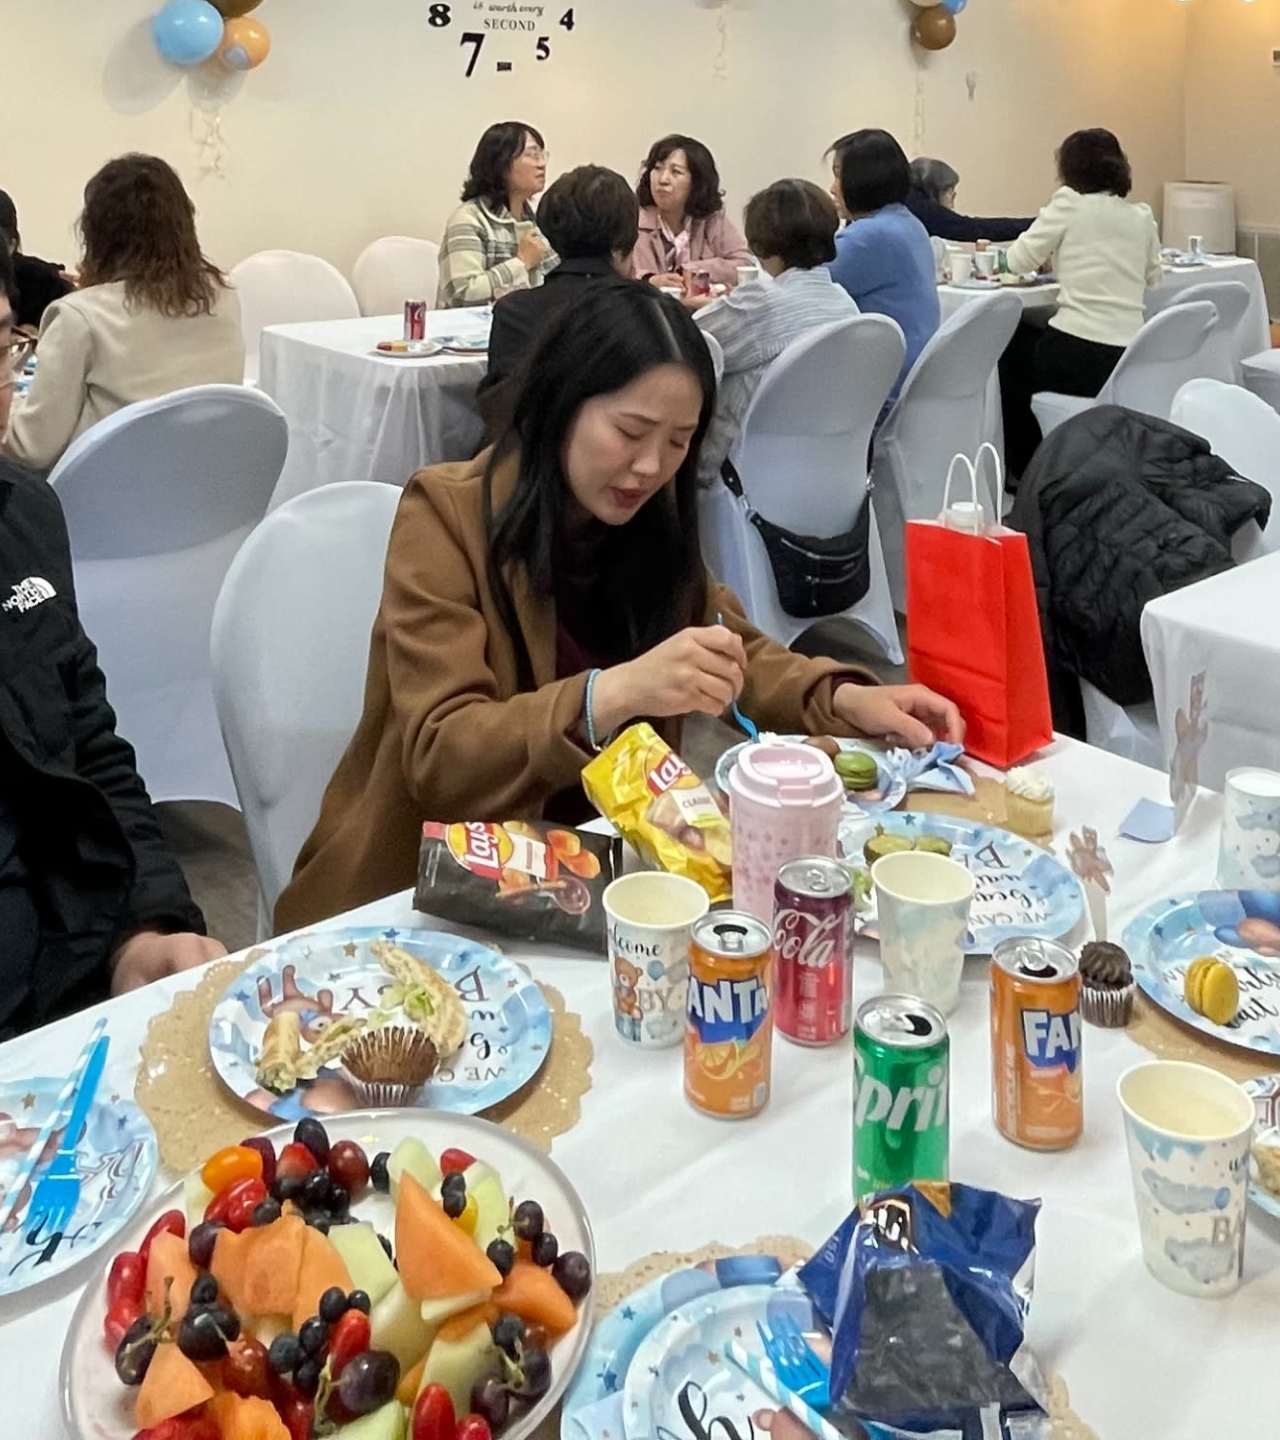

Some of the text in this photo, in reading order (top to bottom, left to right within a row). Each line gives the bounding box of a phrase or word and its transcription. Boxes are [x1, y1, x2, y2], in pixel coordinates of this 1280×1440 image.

[428, 3, 451, 27] 8
[483, 18, 536, 31] SECOND
[559, 8, 574, 31] 4
[460, 32, 485, 77] 7
[535, 36, 550, 60] 5
